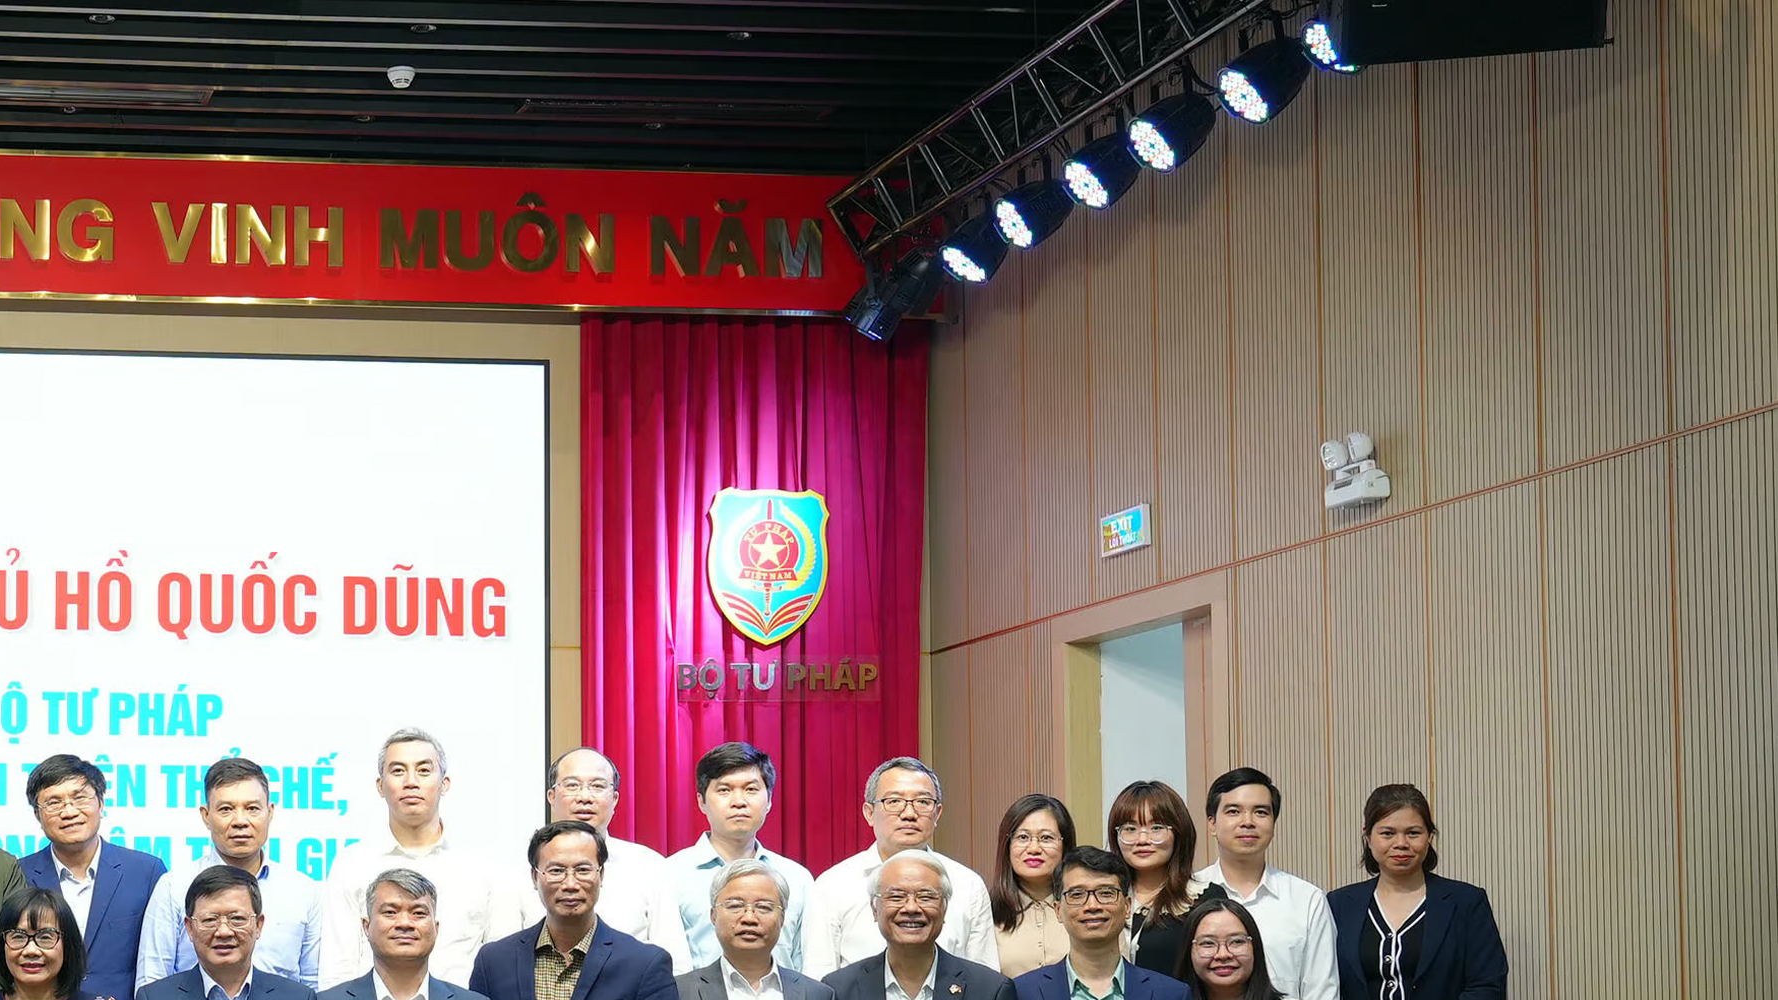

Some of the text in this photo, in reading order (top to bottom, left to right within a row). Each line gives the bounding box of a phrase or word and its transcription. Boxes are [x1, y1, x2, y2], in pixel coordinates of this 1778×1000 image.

[151, 201, 344, 268] VINH
[378, 191, 615, 276] MUÔN
[648, 198, 823, 279] NĂM
[55, 549, 132, 632] HỒ
[158, 551, 317, 640] QUỐC
[343, 564, 507, 638] DŨNG
[42, 687, 100, 736] TƯ
[109, 683, 224, 737] PHÁP
[677, 657, 878, 698] BỘ TƯ PHÁP
